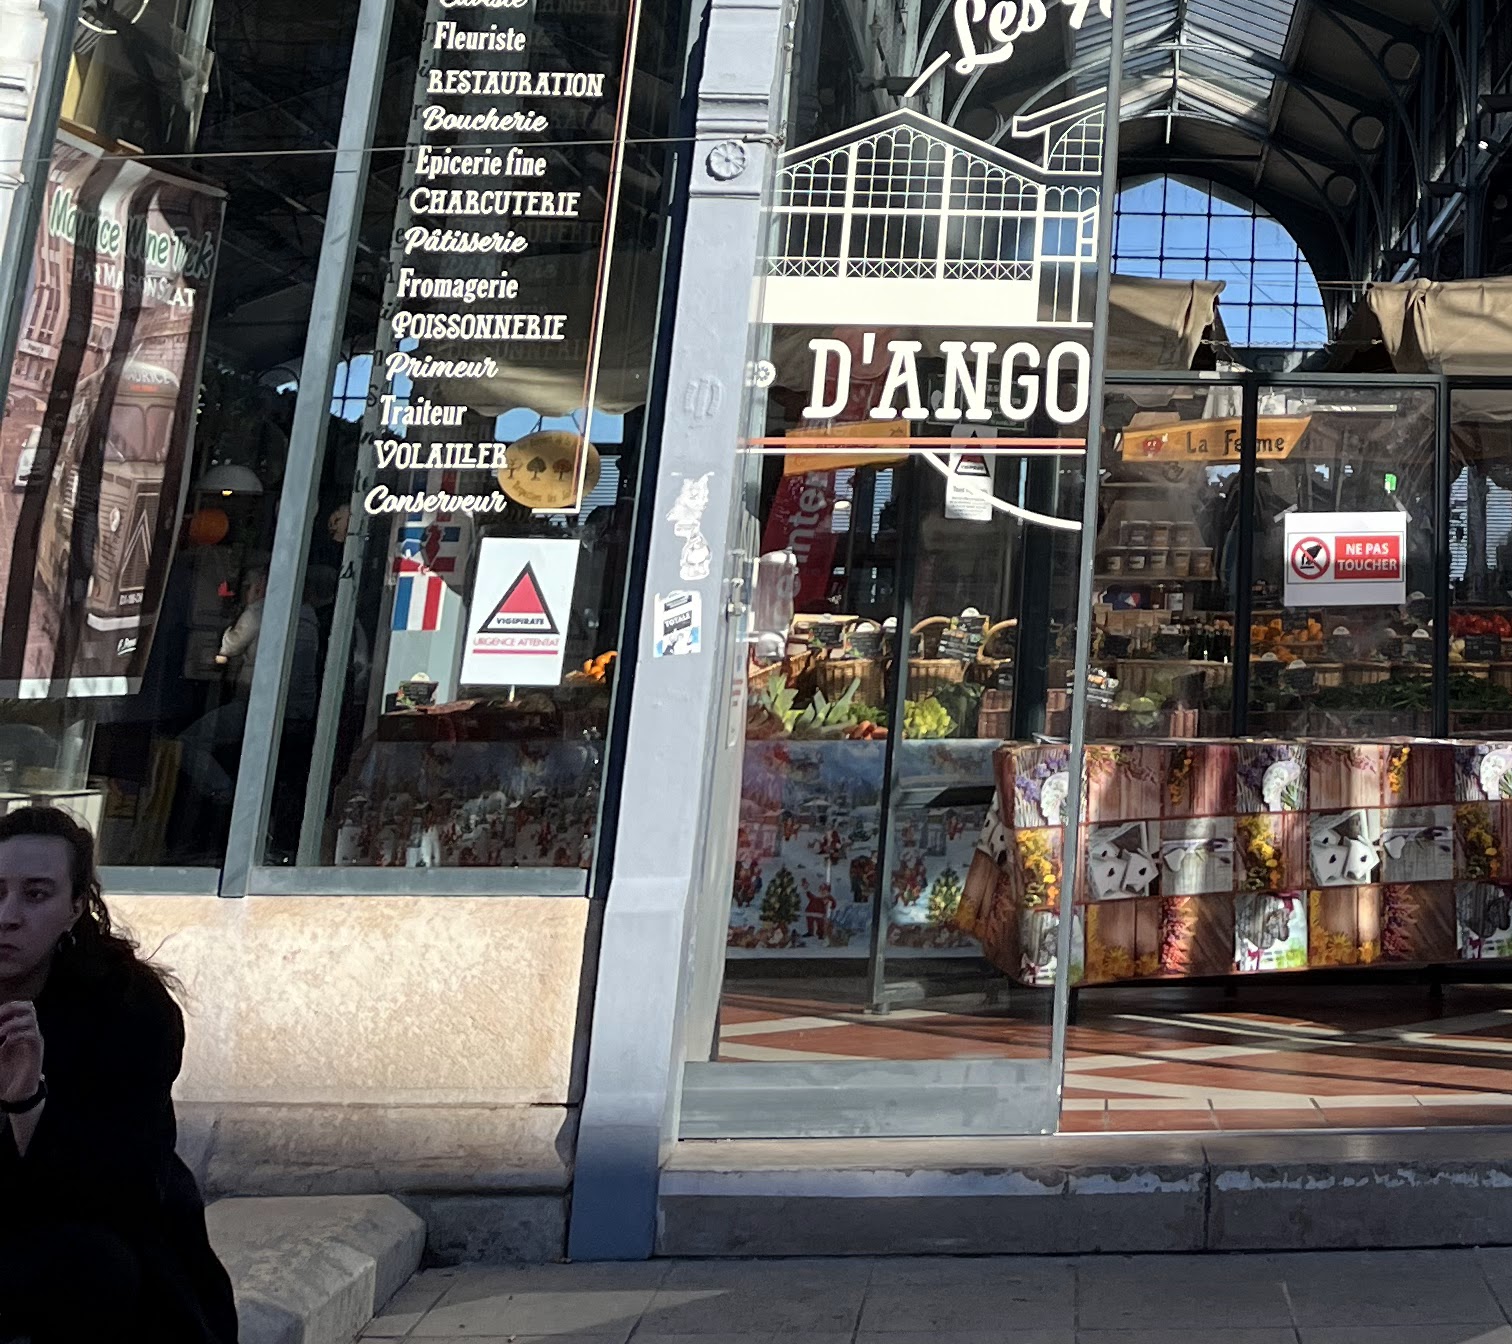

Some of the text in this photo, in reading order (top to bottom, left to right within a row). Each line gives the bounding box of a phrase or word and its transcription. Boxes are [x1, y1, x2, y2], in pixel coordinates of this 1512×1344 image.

[433, 21, 526, 51] Fleuriste
[426, 69, 605, 97] RESTAURATION
[423, 105, 549, 132] Boucherie
[415, 145, 547, 179] Epicerie fine
[409, 187, 581, 216] CHARCUTERIE
[404, 225, 528, 255] Pâtisserie
[396, 268, 519, 303] Fromagerie
[391, 311, 567, 340] POISSONNERIE
[385, 352, 498, 381] Primeur
[802, 332, 1090, 424] D'ANGO
[380, 394, 467, 426] Traiteur
[1186, 429, 1285, 455] La Feme
[364, 484, 507, 514] Conserveur
[1345, 542, 1389, 555] NE PAS
[1337, 559, 1398, 571] TOUCHER
[473, 637, 560, 647] URGENCE ATTENTAT
